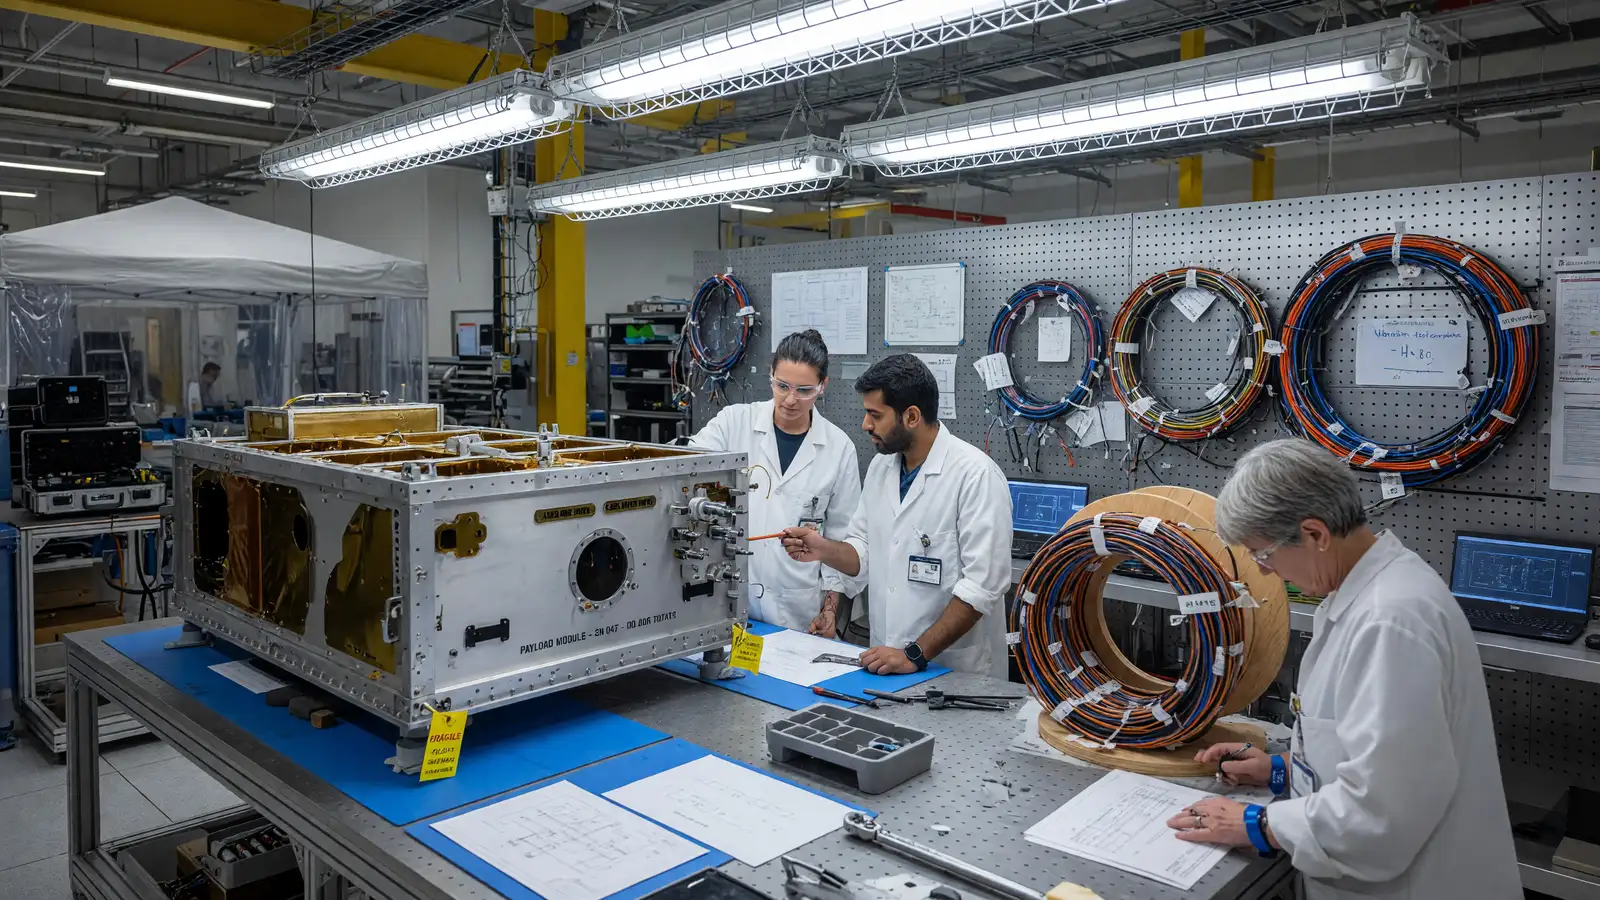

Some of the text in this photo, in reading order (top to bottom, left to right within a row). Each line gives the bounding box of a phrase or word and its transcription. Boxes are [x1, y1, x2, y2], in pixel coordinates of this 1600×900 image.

[520, 638, 554, 655] PAYLOAD
[556, 631, 587, 647] MODULE
[430, 732, 462, 743] FRAGILE
